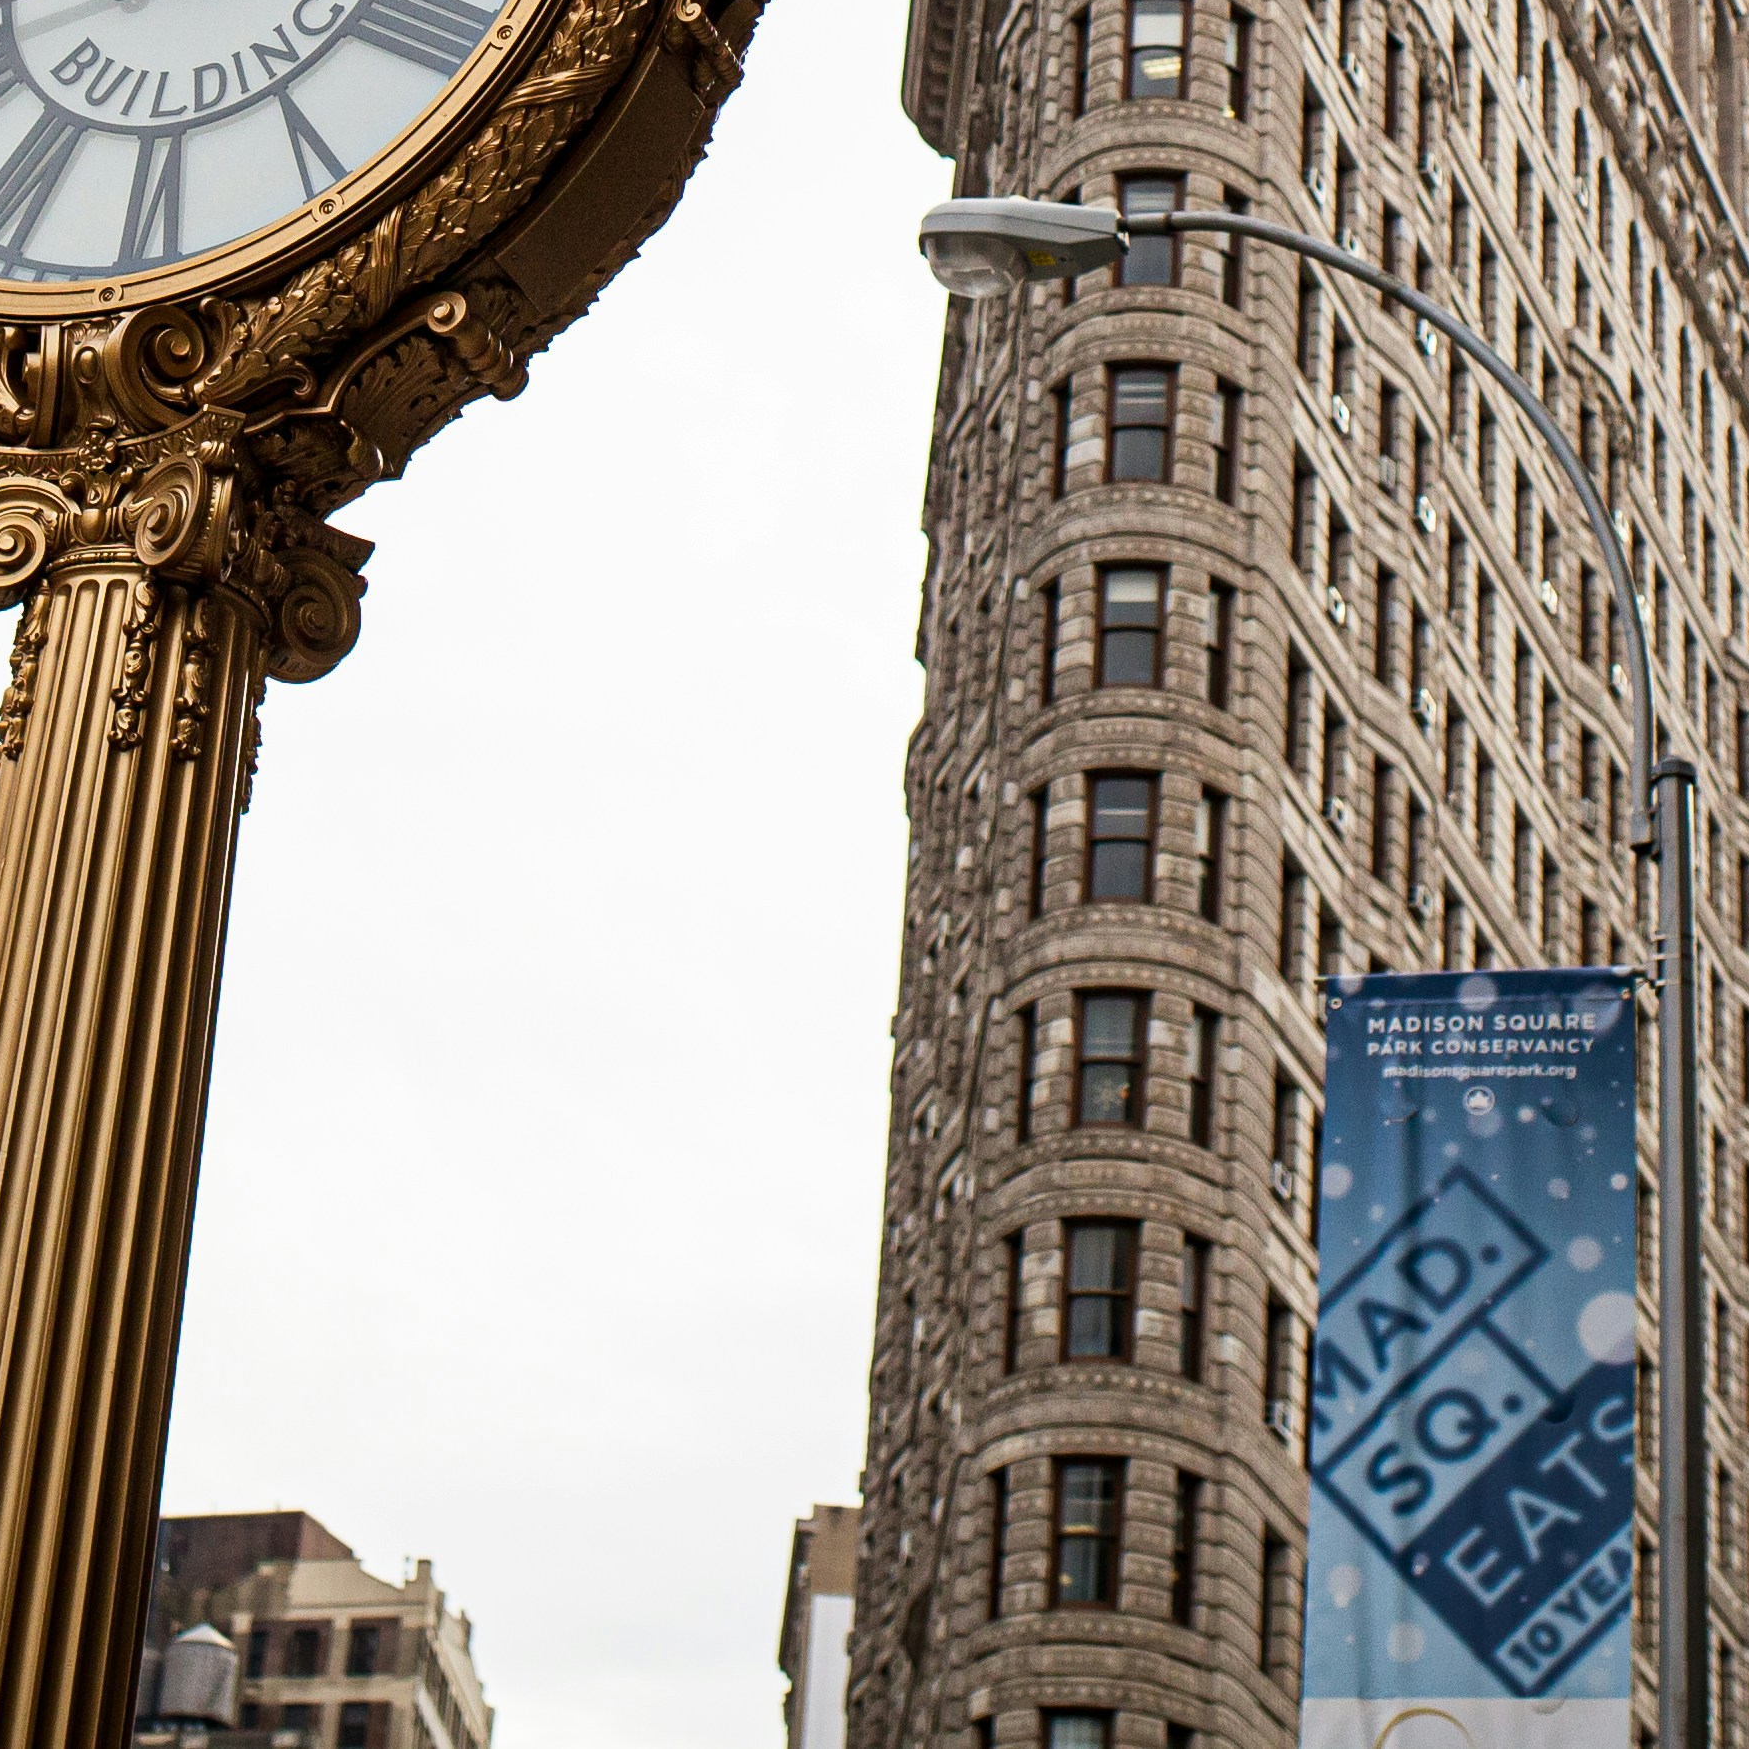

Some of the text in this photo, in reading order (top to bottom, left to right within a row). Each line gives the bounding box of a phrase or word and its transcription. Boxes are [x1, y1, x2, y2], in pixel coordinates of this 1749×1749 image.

[113, 131, 187, 266] VI
[275, 84, 353, 204] V
[1367, 1012, 1597, 1034] MADISON SQUARE
[1367, 1038, 1595, 1056] PARK CONSERVANCY
[1382, 1063, 1577, 1081] madisonsquarepark.org
[1313, 1236, 1502, 1434] MAD.
[1365, 1387, 1525, 1519] SQ.
[1444, 1393, 1635, 1607] EATS
[1508, 1619, 1564, 1672] 10
